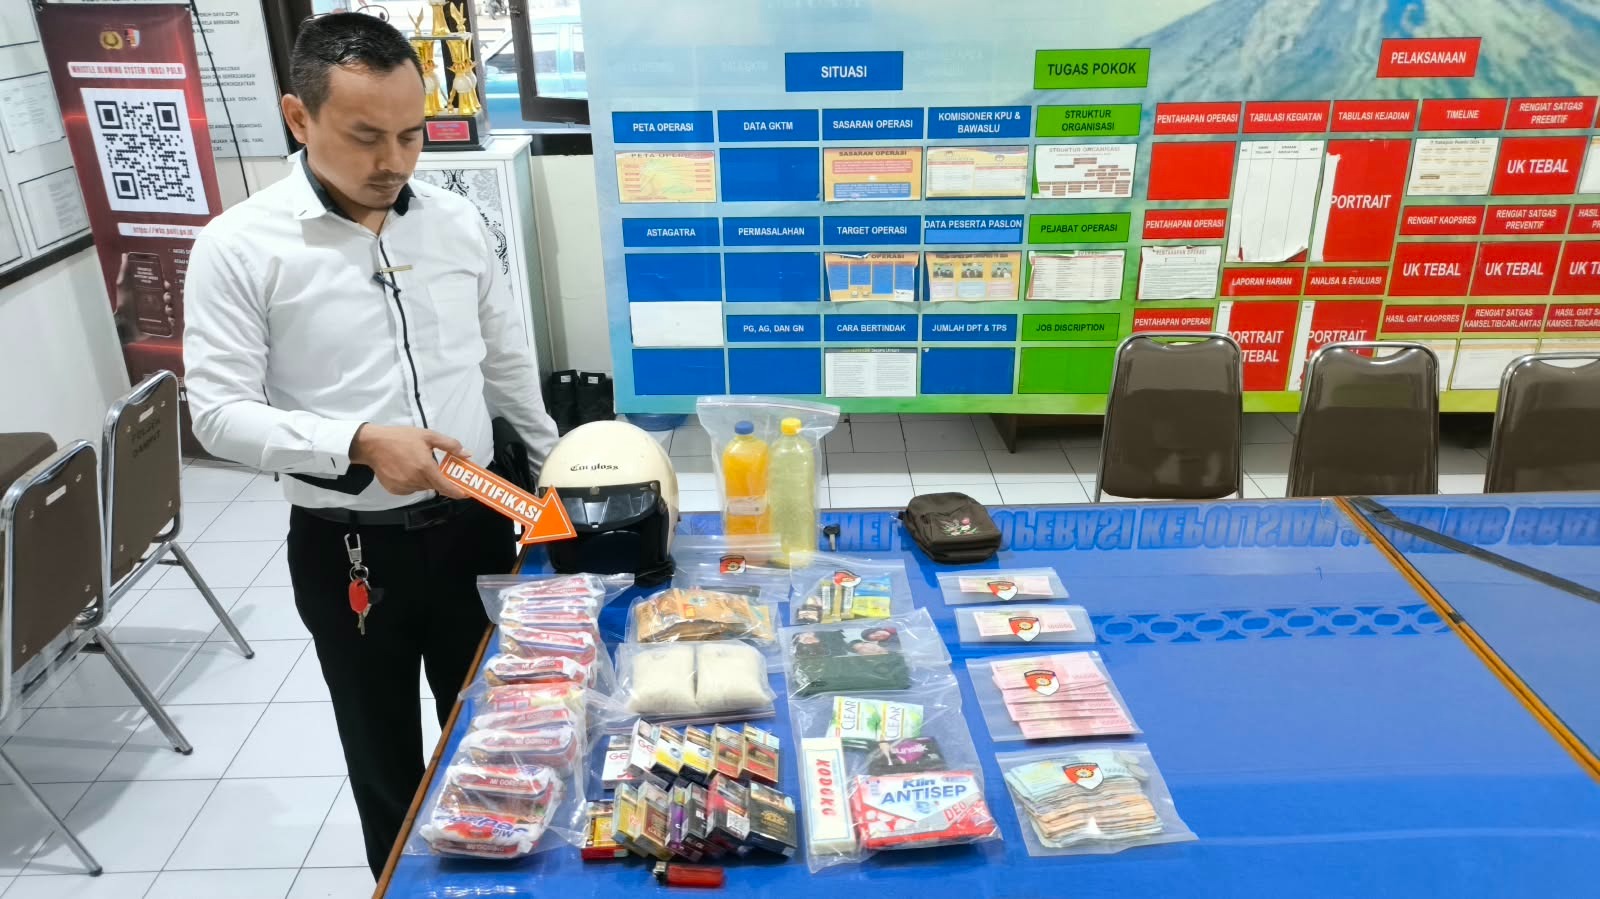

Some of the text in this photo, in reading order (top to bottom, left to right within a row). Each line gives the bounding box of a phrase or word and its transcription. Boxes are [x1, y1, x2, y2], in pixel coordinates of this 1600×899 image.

[1391, 52, 1466, 64] PELAKSANAAN
[821, 66, 866, 78] SITUASI
[1048, 63, 1136, 75] TUGAS POKOK
[1520, 102, 1583, 111] RENGIAT SATGAS
[939, 112, 992, 120] KOMISIONER
[1014, 112, 1021, 120] &
[1065, 110, 1111, 118] STRUKTUR
[1157, 114, 1238, 123] PENTAHAPAN OPERASI
[1250, 113, 1322, 122] TABULASI KEGIATAN
[1339, 112, 1409, 120] TABULASI KEJADIAN
[1447, 110, 1479, 119] TIMELINE
[1531, 115, 1568, 123] PREEMTIF
[657, 123, 693, 131] OPERASI
[744, 122, 793, 130] DATA GKTM
[833, 120, 912, 128] SASARAN OPERASI
[1062, 123, 1114, 131] ORGANISASI
[958, 125, 1000, 133] BAWASLU
[1507, 159, 1568, 173] UK TEBAL
[1331, 195, 1390, 209] PORTRAIT
[1496, 210, 1527, 218] RENGIAT
[1578, 209, 1598, 217] HASIL
[924, 220, 947, 229] DATA
[949, 220, 986, 228] PESERTA
[1146, 220, 1192, 228] PENTAHAPAN
[1408, 216, 1476, 224] RENGIAT KAOPSRES
[1081, 224, 1117, 232] OPERASI
[1506, 221, 1544, 229] PREVENTIF
[1403, 263, 1461, 276] UK TEBAL
[1486, 263, 1543, 275] UK TEBAL
[1570, 262, 1588, 275] UK
[1231, 278, 1265, 287] LAPORAN
[1311, 277, 1339, 285] ANALISA
[1341, 277, 1347, 285] &
[1135, 318, 1179, 326] PENTAHAPAN
[1464, 320, 1542, 328] KAMSELTIBCARLANTAS
[1241, 350, 1279, 362] TEBAL
[446, 462, 543, 522] IDENTIFIKASI
[841, 701, 857, 731] CLEAR
[880, 784, 967, 805] ANTISEP
[943, 801, 967, 822] DEO
